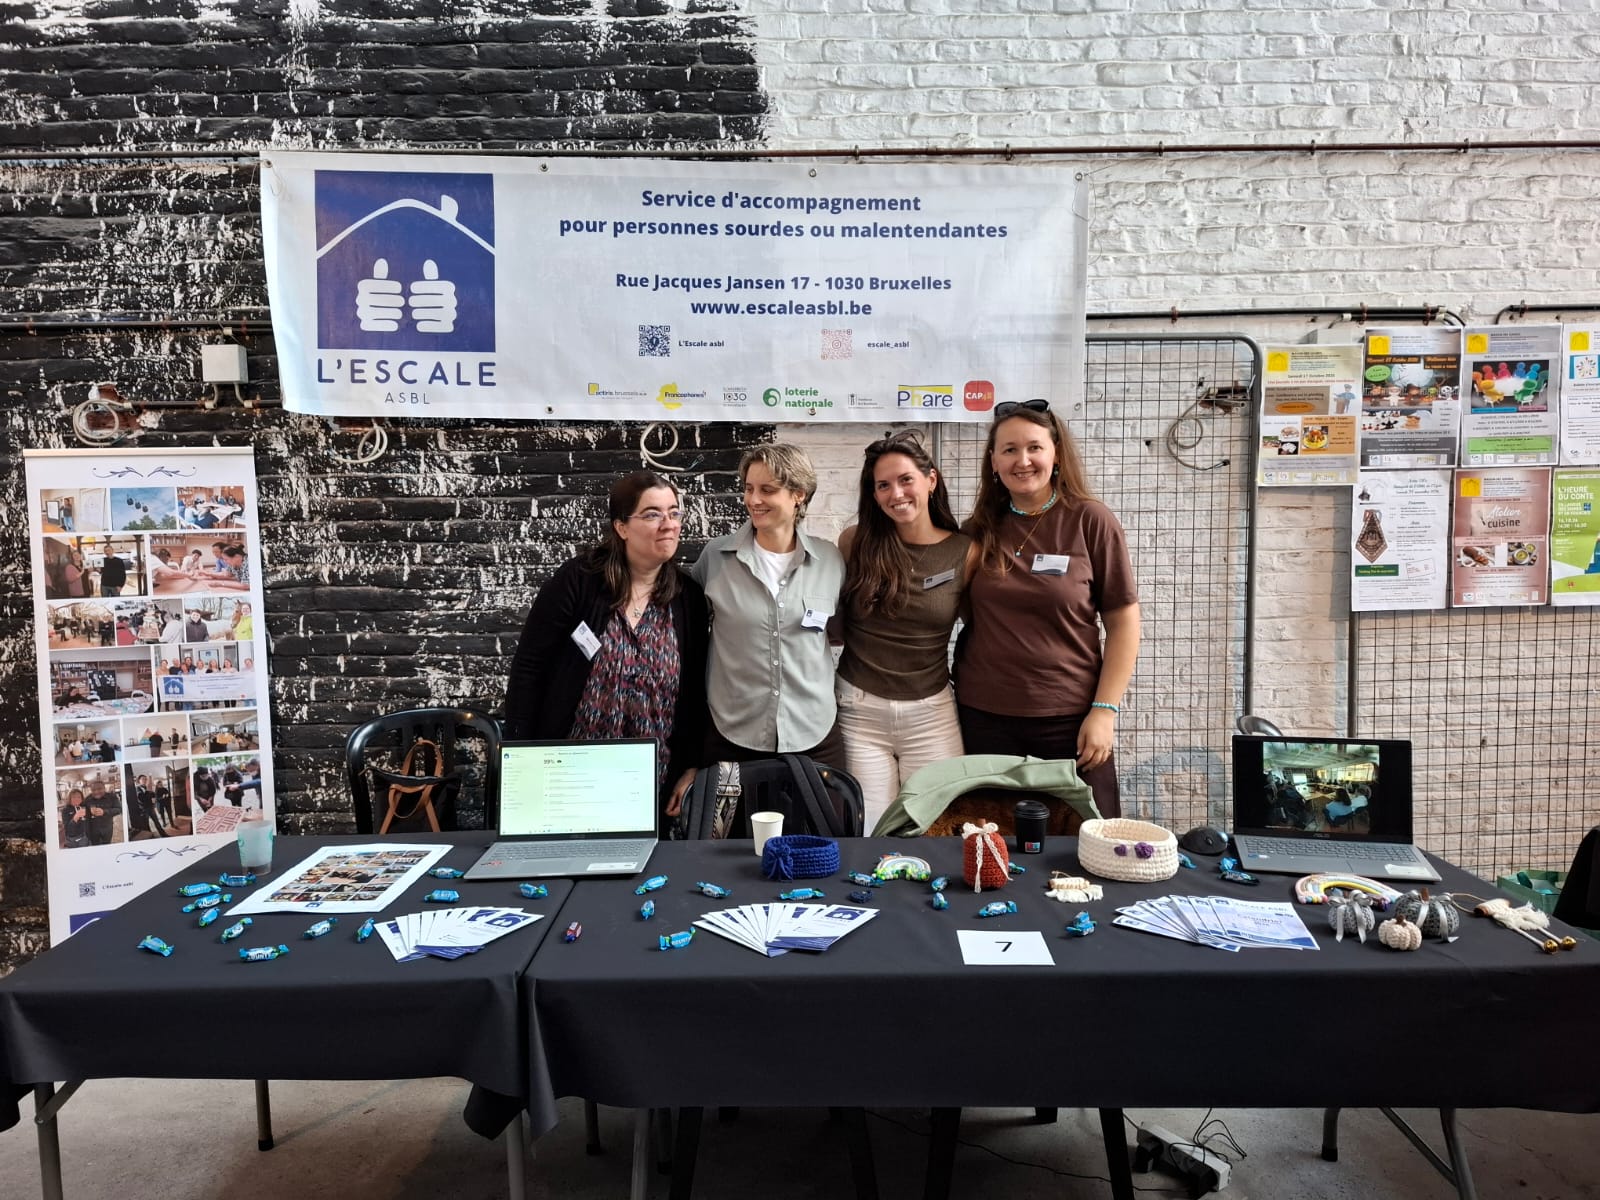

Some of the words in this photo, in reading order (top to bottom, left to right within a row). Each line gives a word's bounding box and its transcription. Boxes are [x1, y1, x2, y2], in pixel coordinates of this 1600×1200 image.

[642, 190, 716, 208] Service
[722, 191, 921, 214] d'accompagnement
[560, 219, 607, 236] pour
[613, 221, 719, 238] personnes
[725, 220, 804, 237] sourdes
[810, 225, 835, 237] ou
[841, 222, 1008, 238] malentendantes
[616, 274, 649, 288] Rue
[652, 274, 722, 293] Jacques
[725, 276, 785, 292] Jansen
[791, 276, 810, 290] 17
[825, 276, 864, 290] 1030
[869, 276, 952, 290] Bruxelles
[691, 300, 872, 315] www.escaleasbl.be
[867, 341, 910, 349] escale_asbl
[317, 358, 497, 387] L'ESCALE
[384, 391, 431, 405] ASBL
[785, 387, 819, 396] loterie
[897, 389, 953, 407] Phare
[785, 398, 834, 408] nationale
[1570, 492, 1594, 500] CONTE
[1487, 518, 1520, 529] cuisine
[995, 941, 1013, 953] 7
